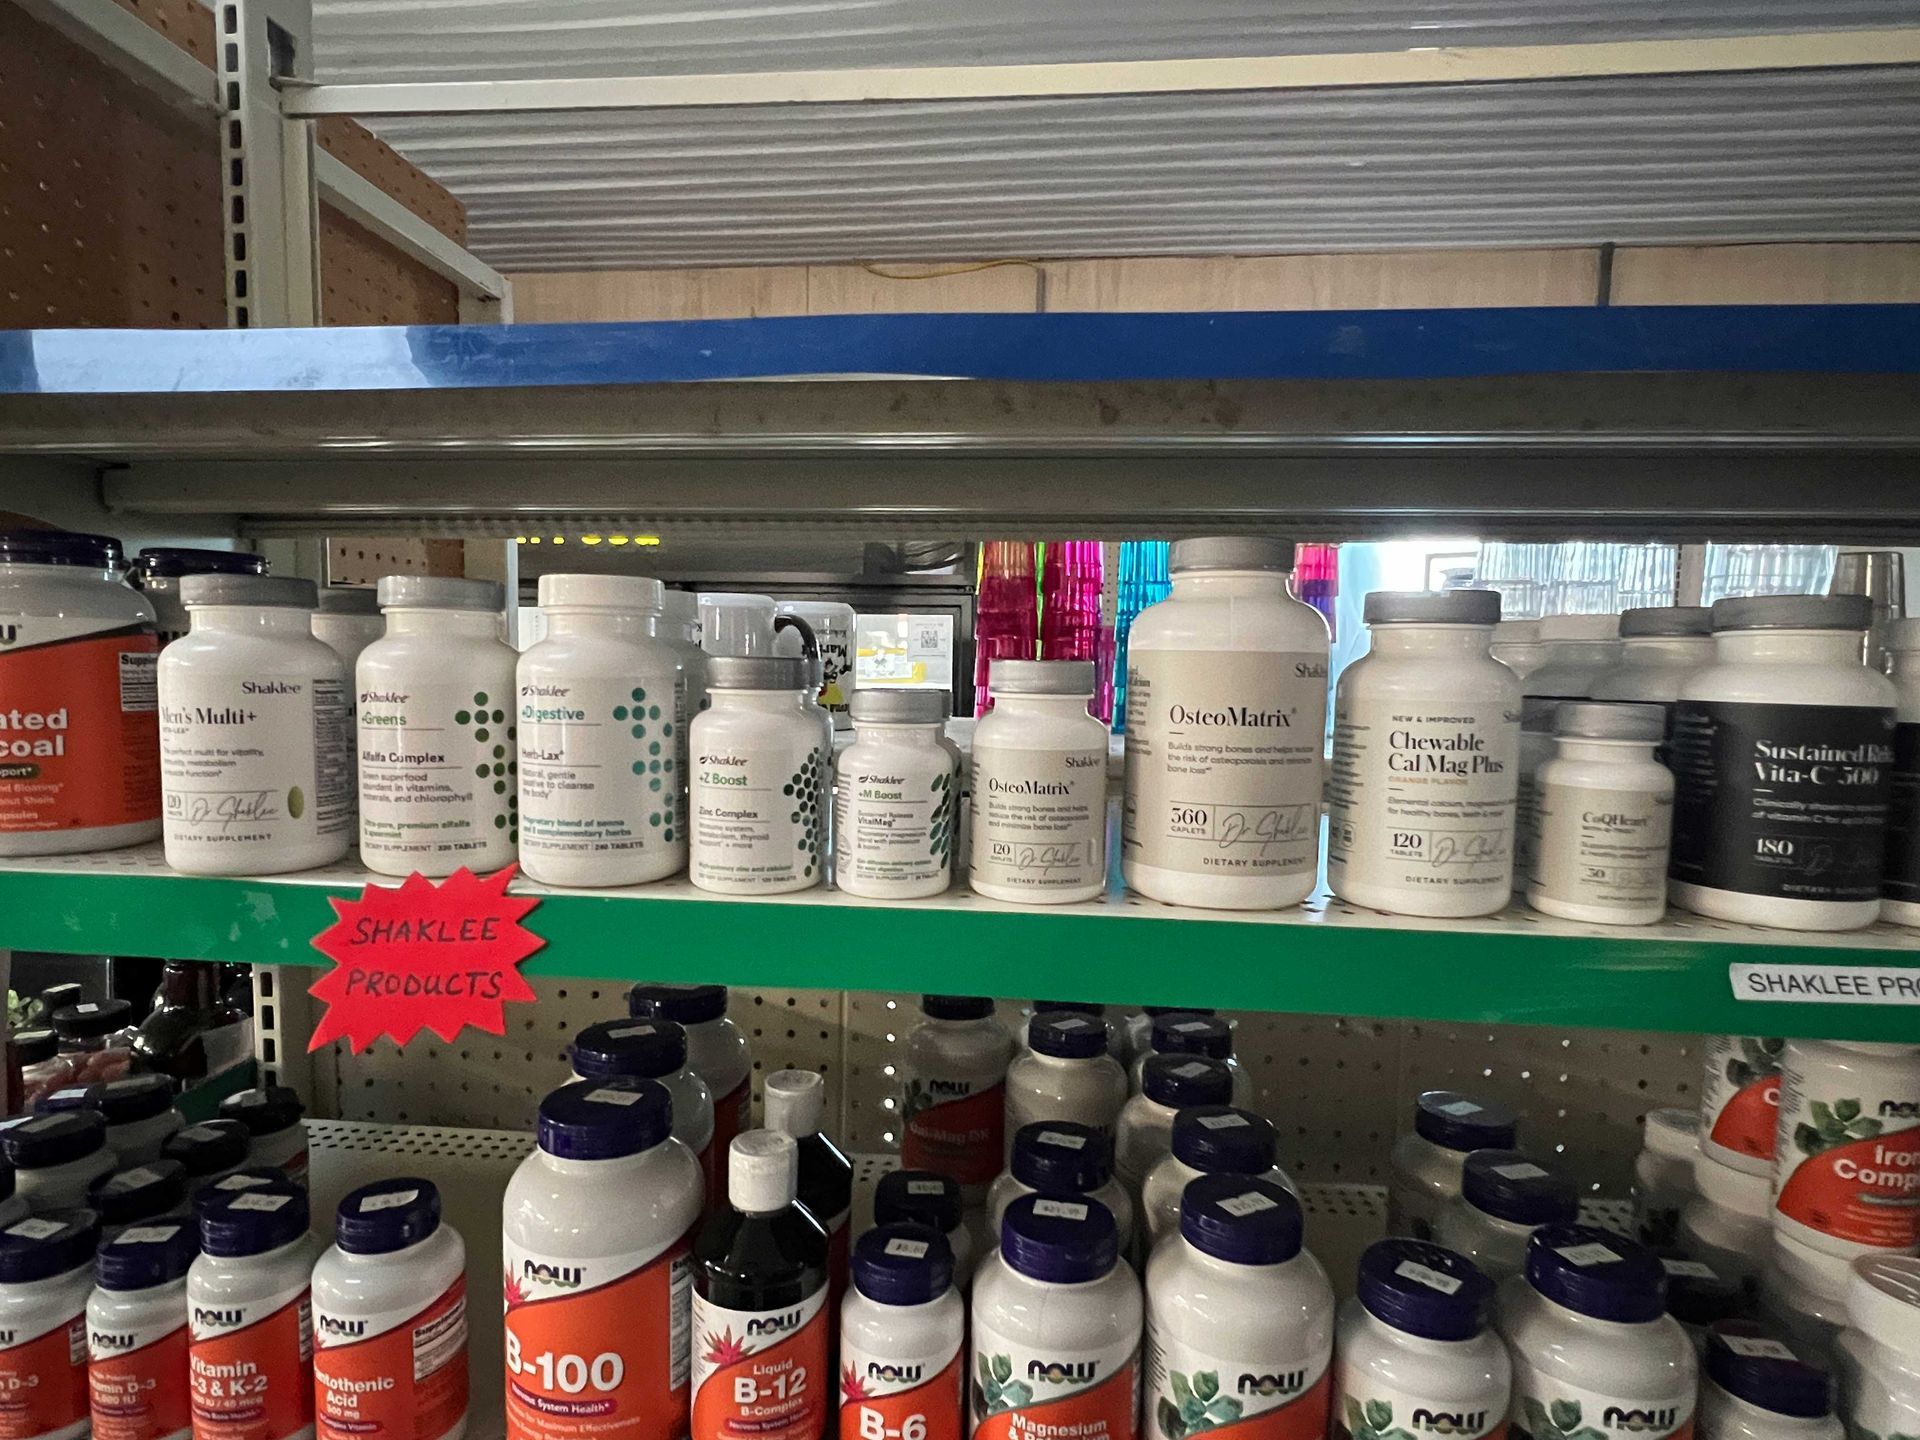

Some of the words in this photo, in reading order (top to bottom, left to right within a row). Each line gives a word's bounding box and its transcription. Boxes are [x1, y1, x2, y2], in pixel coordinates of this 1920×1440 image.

[242, 681, 302, 695] Shaklee
[1389, 731, 1485, 751] Chewable
[1754, 739, 1864, 762] Sustained
[388, 752, 445, 765] Complex
[1183, 754, 1196, 762] risk
[1388, 753, 1421, 773] Cal
[1425, 755, 1469, 777] Mag
[1472, 756, 1504, 774] Plus
[713, 773, 748, 786] Boost
[1754, 762, 1836, 785] Vita-C
[1838, 766, 1880, 785] 500
[874, 790, 902, 800] Boost
[716, 807, 758, 819] Complex
[1171, 807, 1207, 827] 360
[1171, 825, 1207, 835] CAPLETS
[993, 843, 1011, 855] 120
[1393, 833, 1422, 848] 120
[1757, 838, 1794, 855] 180
[1203, 857, 1248, 867] DIETARY
[350, 916, 501, 945] SHAKLEE
[345, 968, 503, 999] PRODUCTS
[1748, 973, 1872, 996] SHAKLEE
[1877, 976, 1920, 998] PR
[190, 1352, 257, 1379] Vitamin
[506, 1326, 624, 1393] B-100
[753, 1358, 793, 1375] Liquid
[210, 1383, 225, 1397] &
[230, 1375, 268, 1396] K-2
[734, 1366, 807, 1404] B-12
[326, 1389, 357, 1408] Acid
[538, 1398, 568, 1413] System
[740, 1396, 803, 1416] B-Complex
[860, 1406, 927, 1440] B-6
[1012, 1412, 1107, 1437] Magnesium
